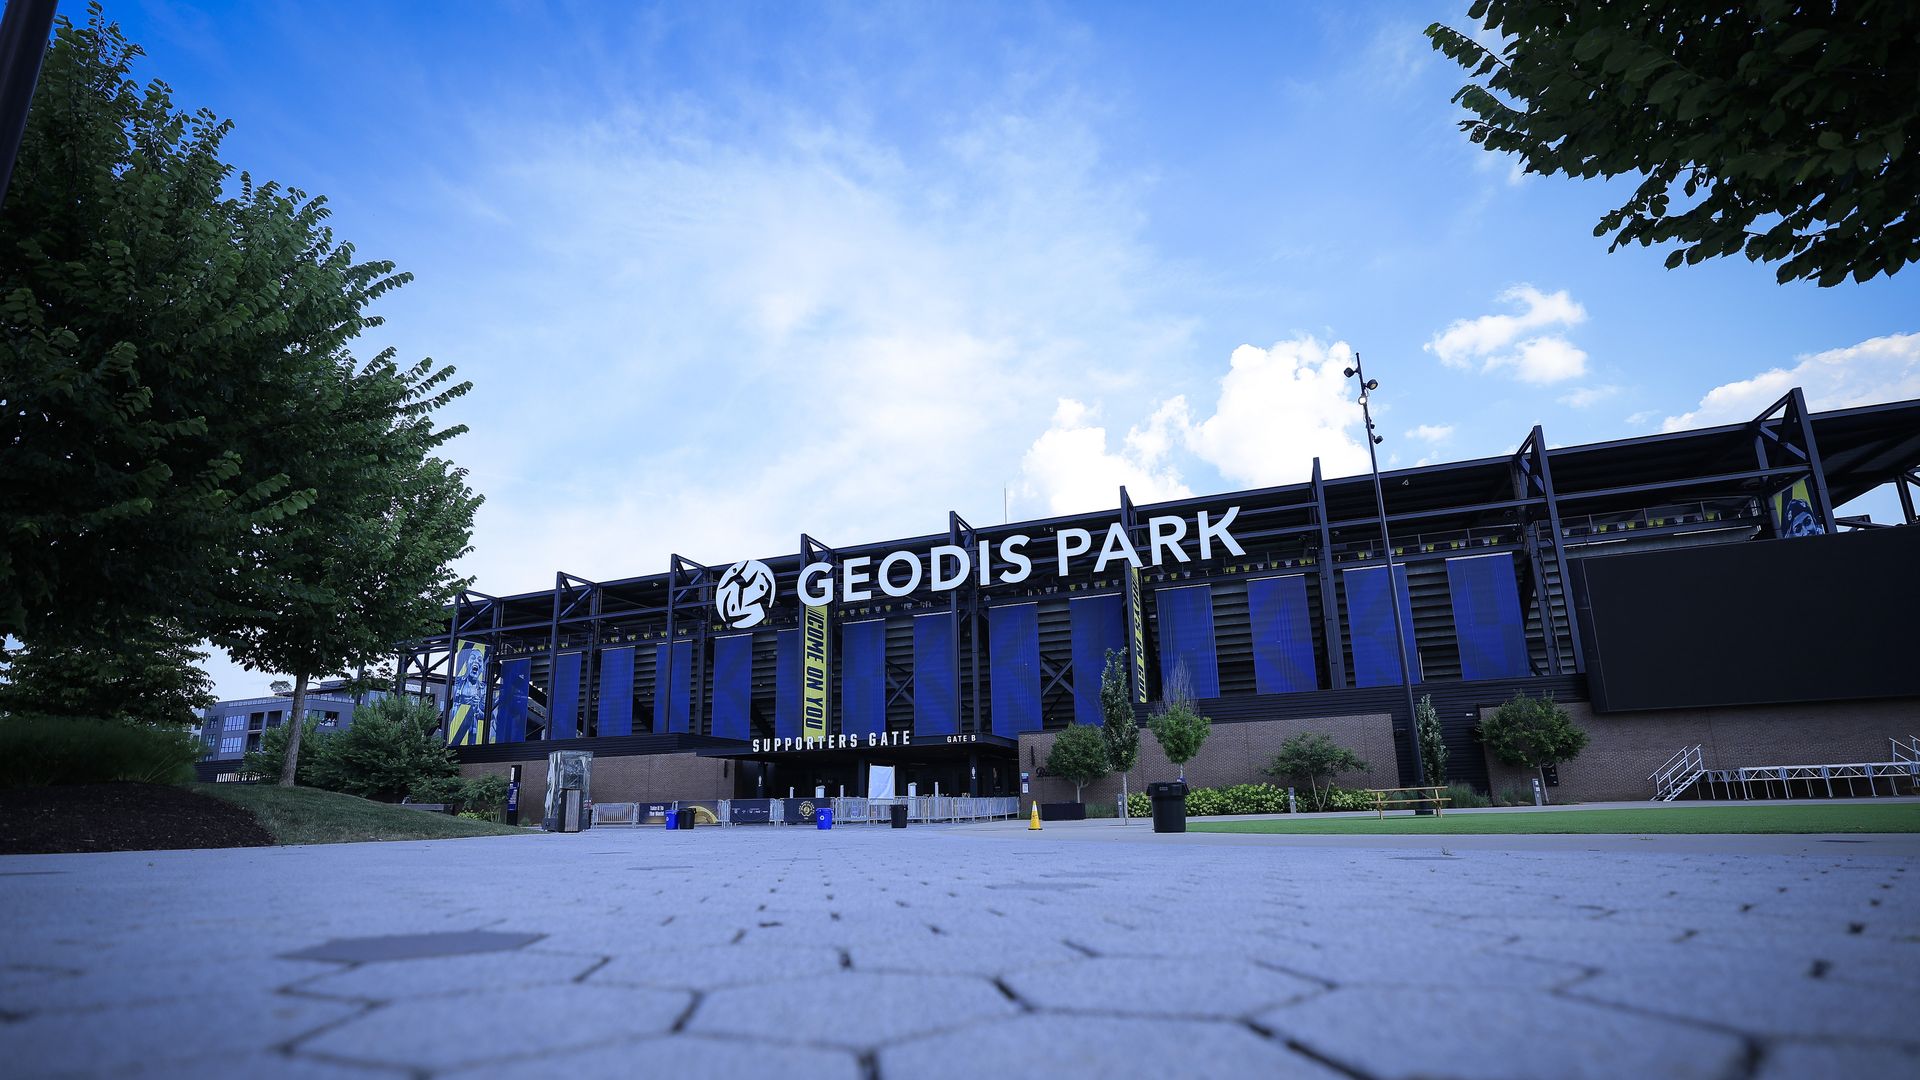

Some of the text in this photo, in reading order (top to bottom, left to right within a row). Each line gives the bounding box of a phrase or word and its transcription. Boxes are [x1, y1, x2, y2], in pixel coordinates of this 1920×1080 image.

[796, 506, 1247, 607] GEODIS PARK
[805, 614, 824, 730] COME ON YOU
[752, 731, 910, 753] SUPPORTERS GATE
[946, 735, 968, 743] GATE
